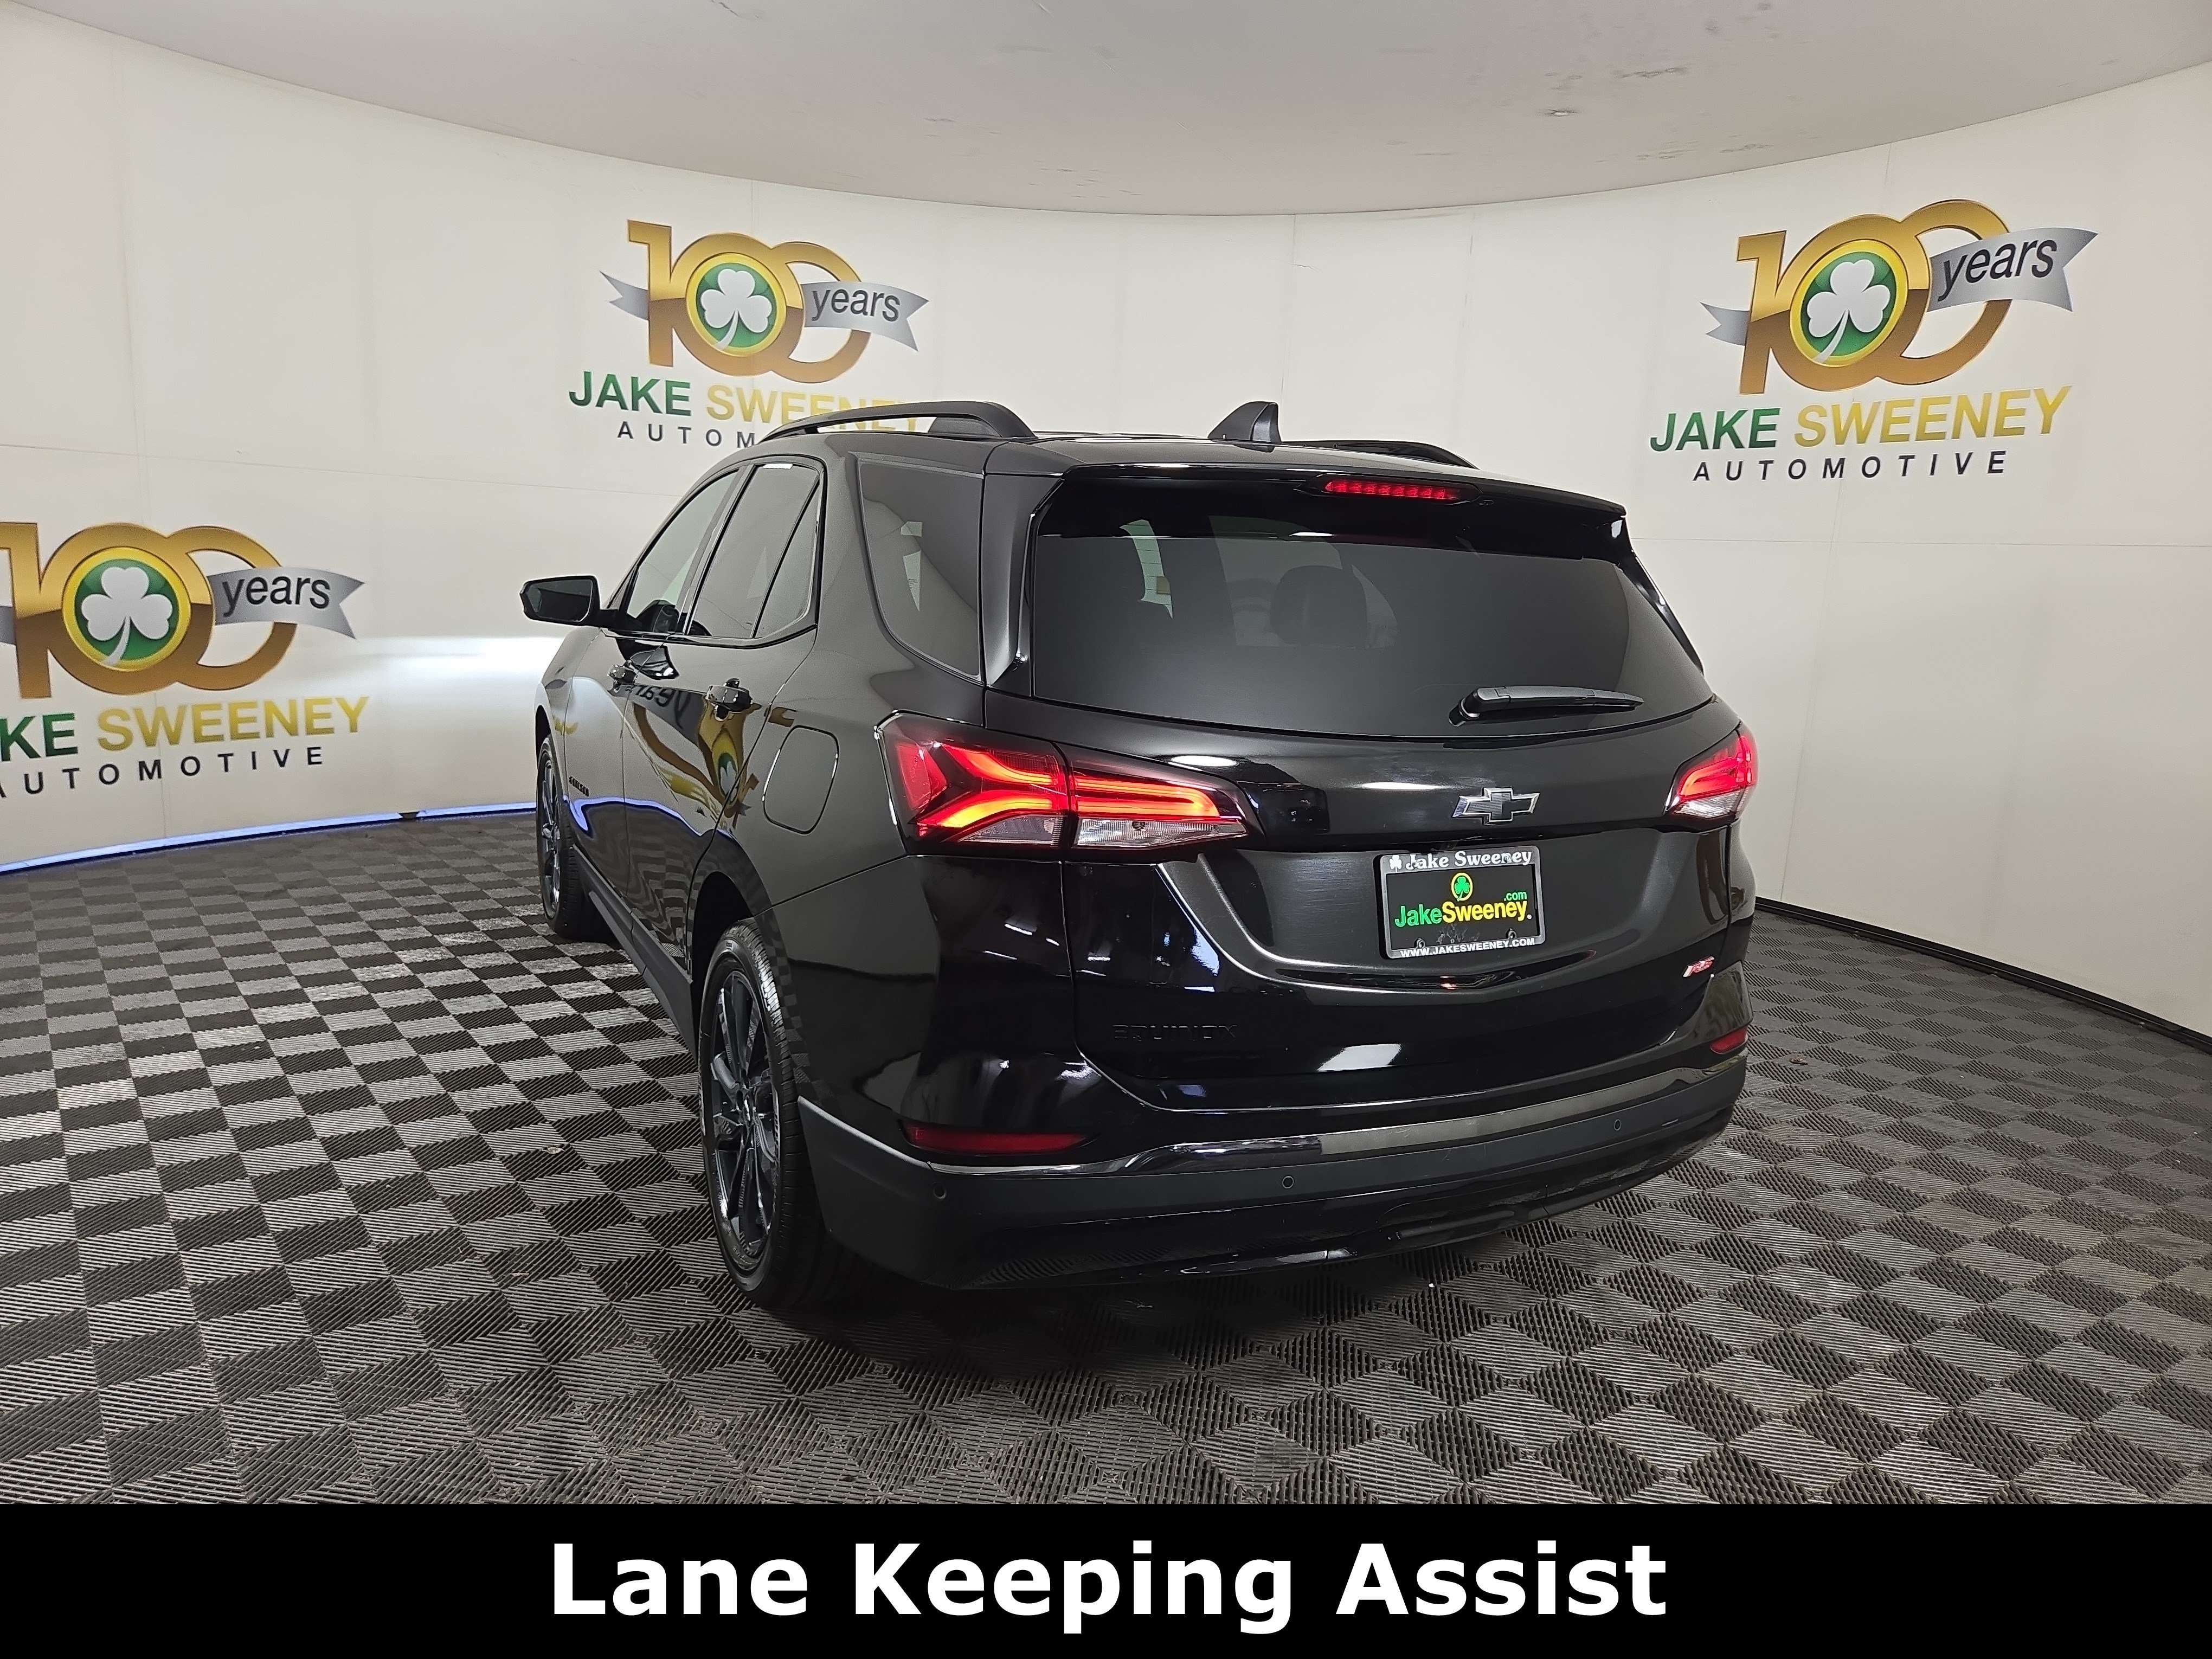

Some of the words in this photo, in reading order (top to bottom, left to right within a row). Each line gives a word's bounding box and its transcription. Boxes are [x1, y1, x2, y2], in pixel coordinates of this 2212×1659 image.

[1938, 240, 2057, 301] years
[812, 289, 901, 322] years
[569, 371, 691, 416] JAKE
[1650, 408, 1780, 451] JAKE
[1794, 385, 2072, 447] SWEENEY
[1693, 451, 2007, 481] AUTOMOTIVE
[221, 576, 331, 617] years
[98, 696, 370, 751] SWEENEY
[1405, 853, 1449, 870] Jake
[1455, 851, 1532, 866] Sweeney
[1503, 891, 1527, 902] .com
[1400, 938, 1535, 957] WWW.JAKESWEENEY.COM
